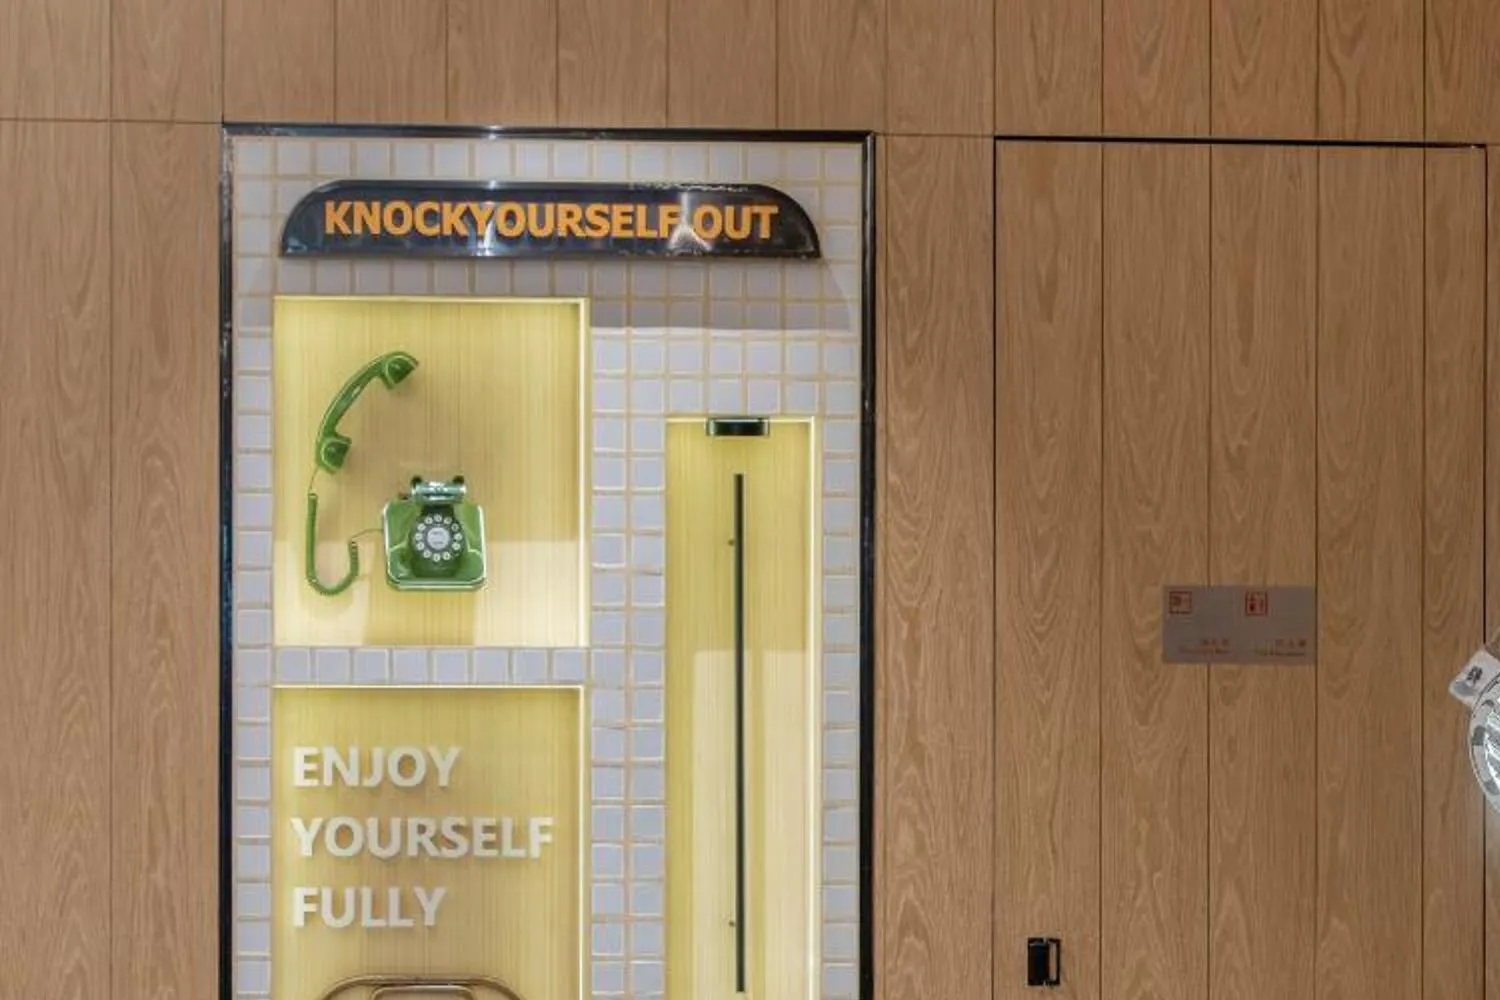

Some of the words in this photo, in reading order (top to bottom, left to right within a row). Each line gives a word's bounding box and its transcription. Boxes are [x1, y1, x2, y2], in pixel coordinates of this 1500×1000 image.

[693, 204, 779, 240] OUT
[292, 745, 462, 788] ENJOY
[290, 816, 554, 859] YOURSELF
[292, 886, 447, 928] FULLY
